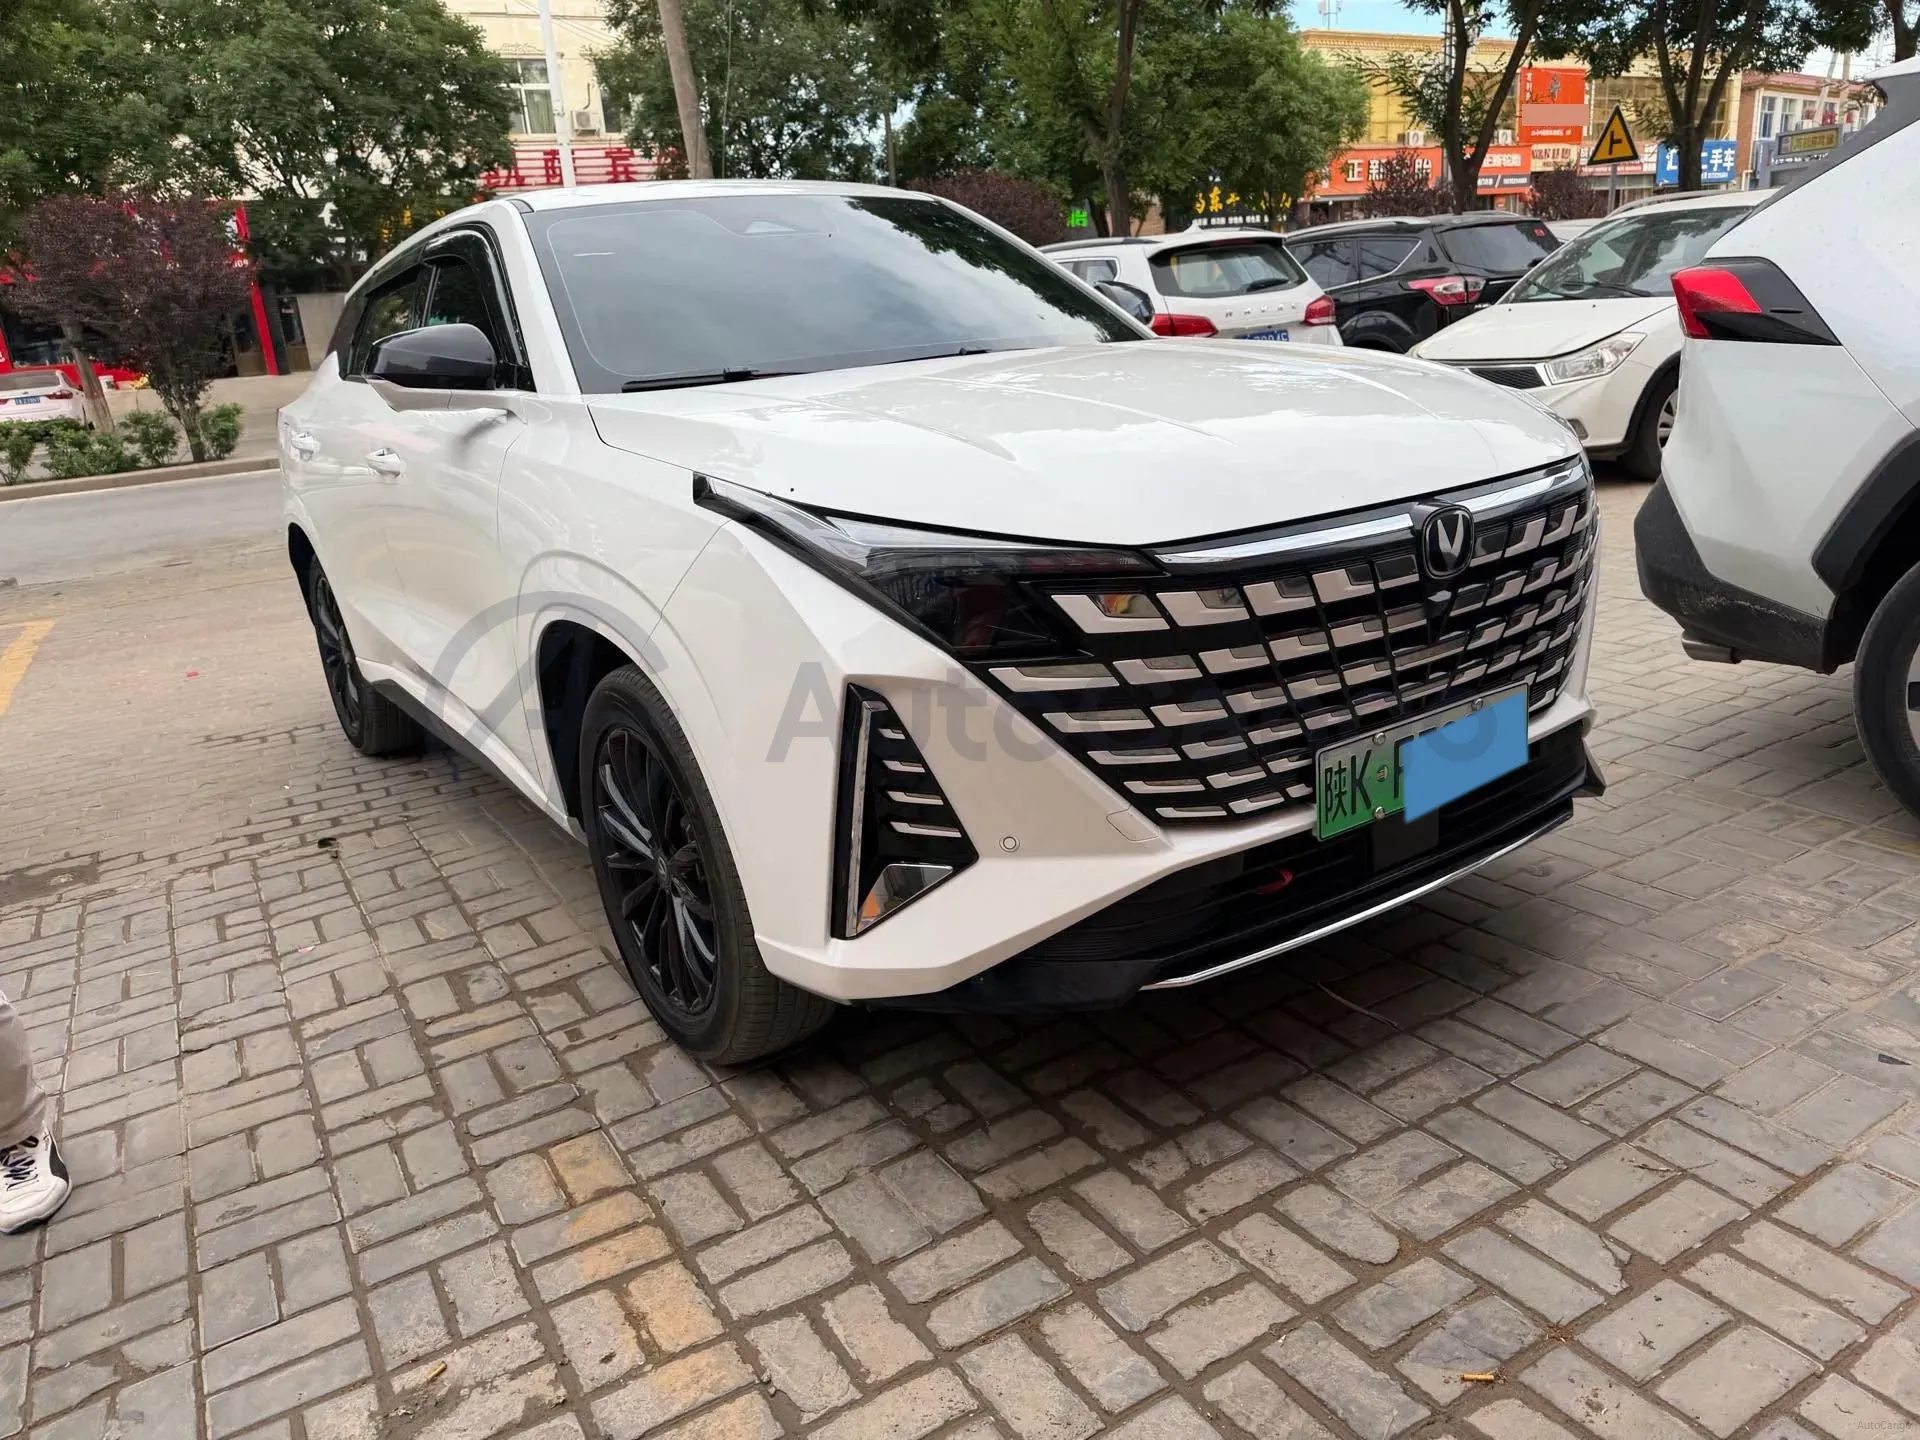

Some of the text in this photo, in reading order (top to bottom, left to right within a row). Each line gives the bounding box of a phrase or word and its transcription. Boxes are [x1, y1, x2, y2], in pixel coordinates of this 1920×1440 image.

[1346, 158, 1433, 182] 正新胎
[1665, 147, 1736, 172] 汇二手车
